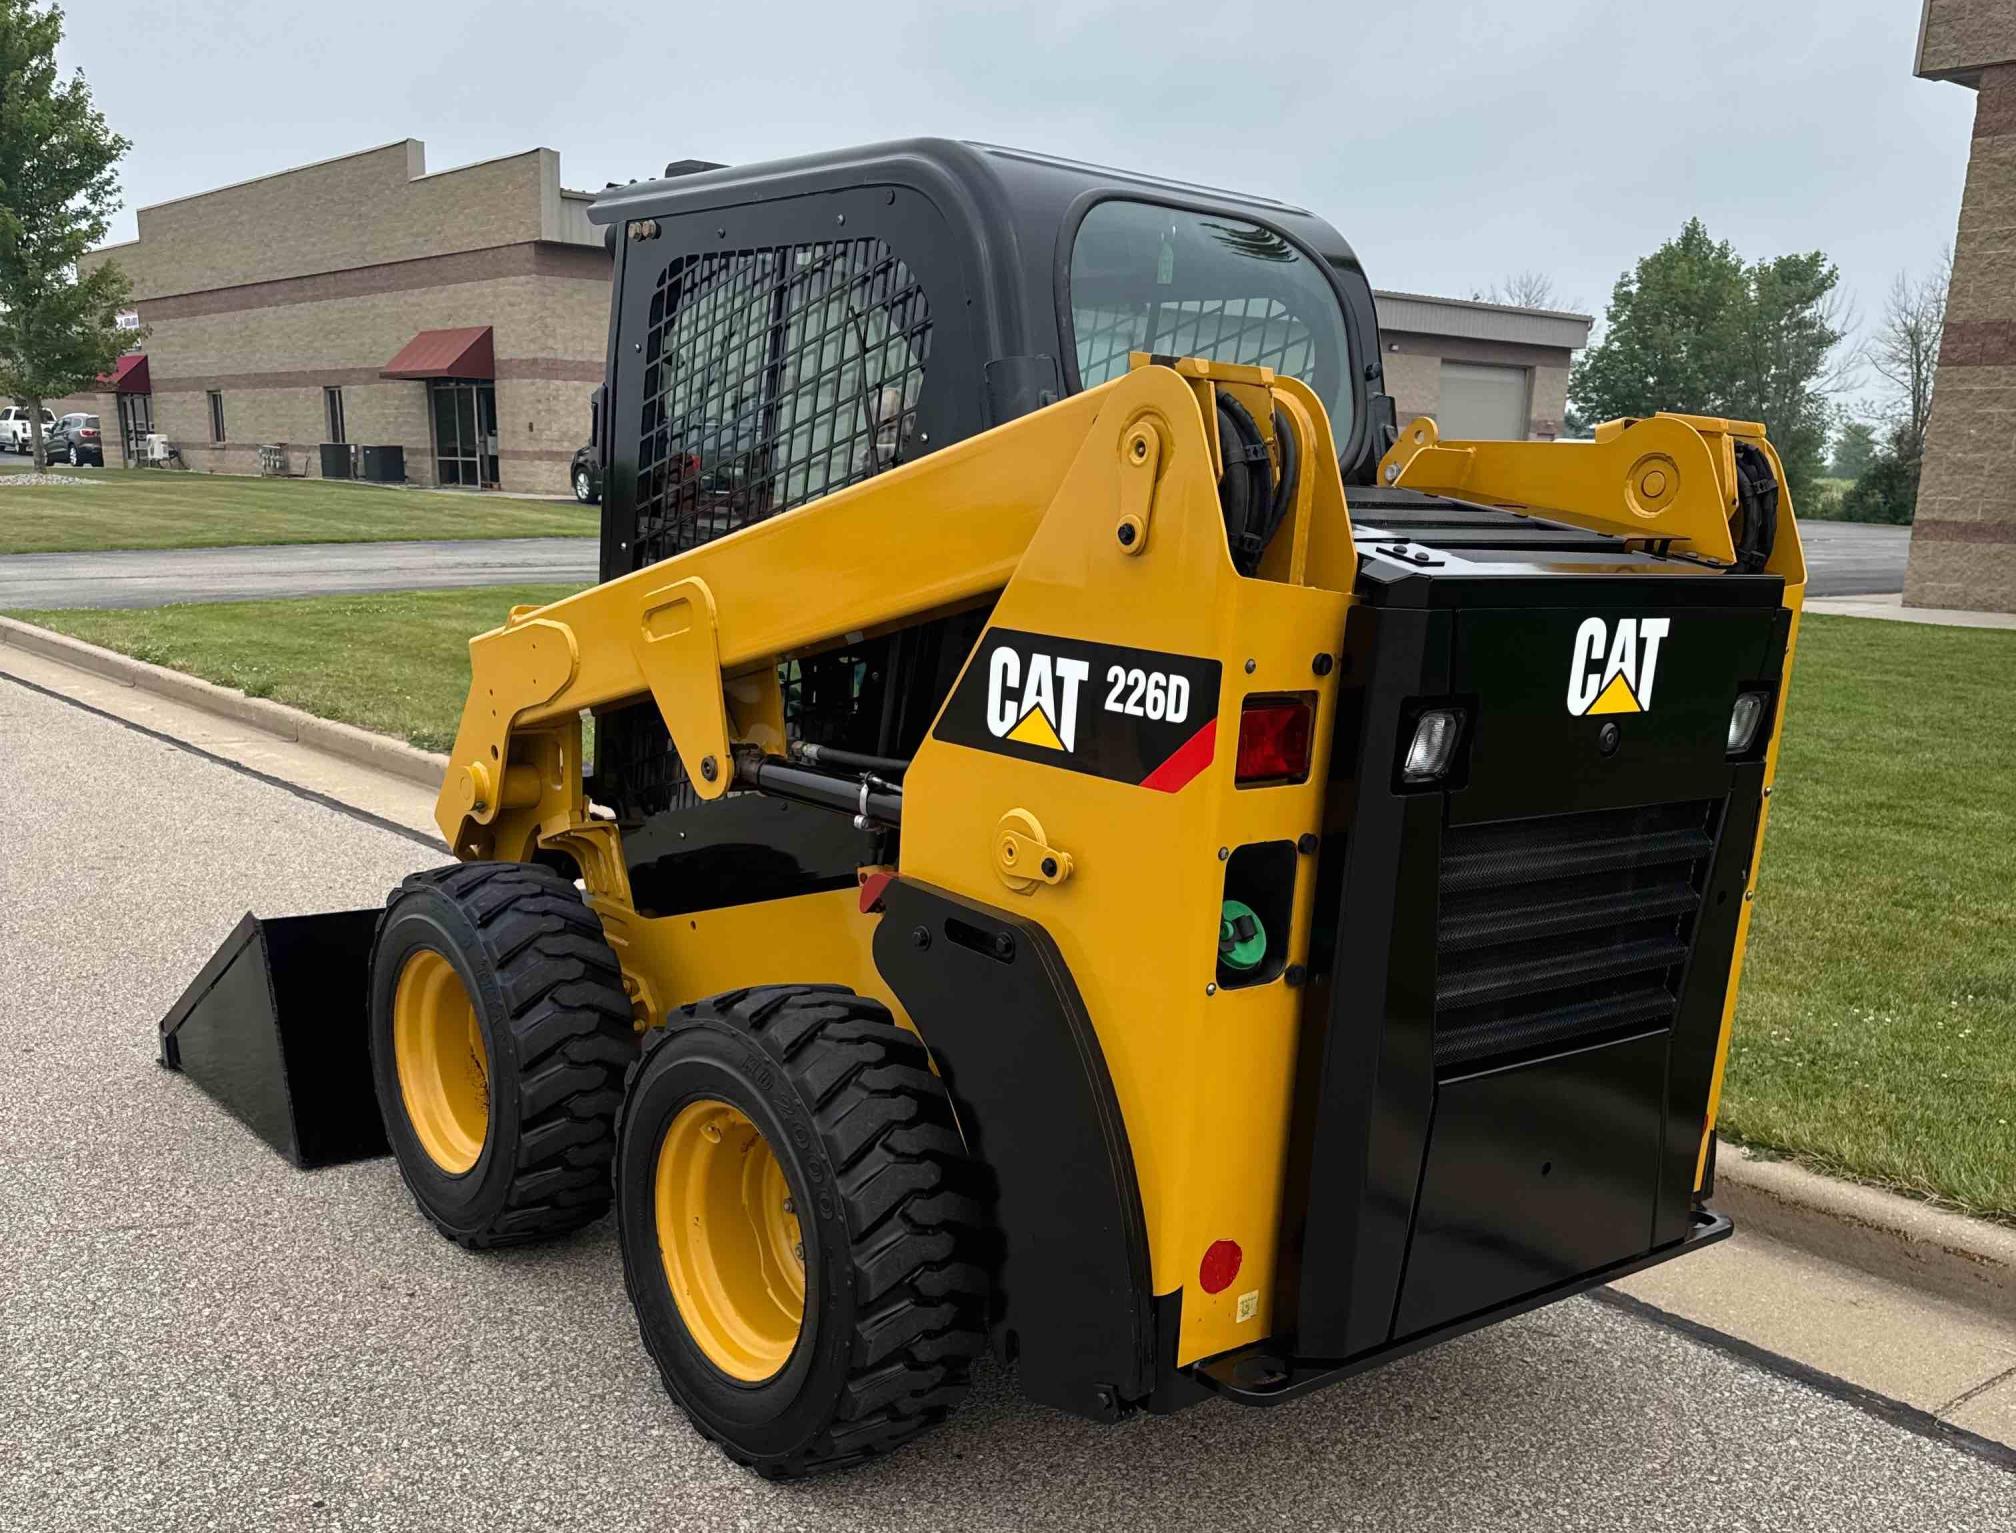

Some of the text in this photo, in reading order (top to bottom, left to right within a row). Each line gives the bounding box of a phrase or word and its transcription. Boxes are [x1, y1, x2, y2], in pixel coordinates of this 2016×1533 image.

[986, 646, 1190, 753] CAT 226D
[1567, 617, 1671, 716] CAT
